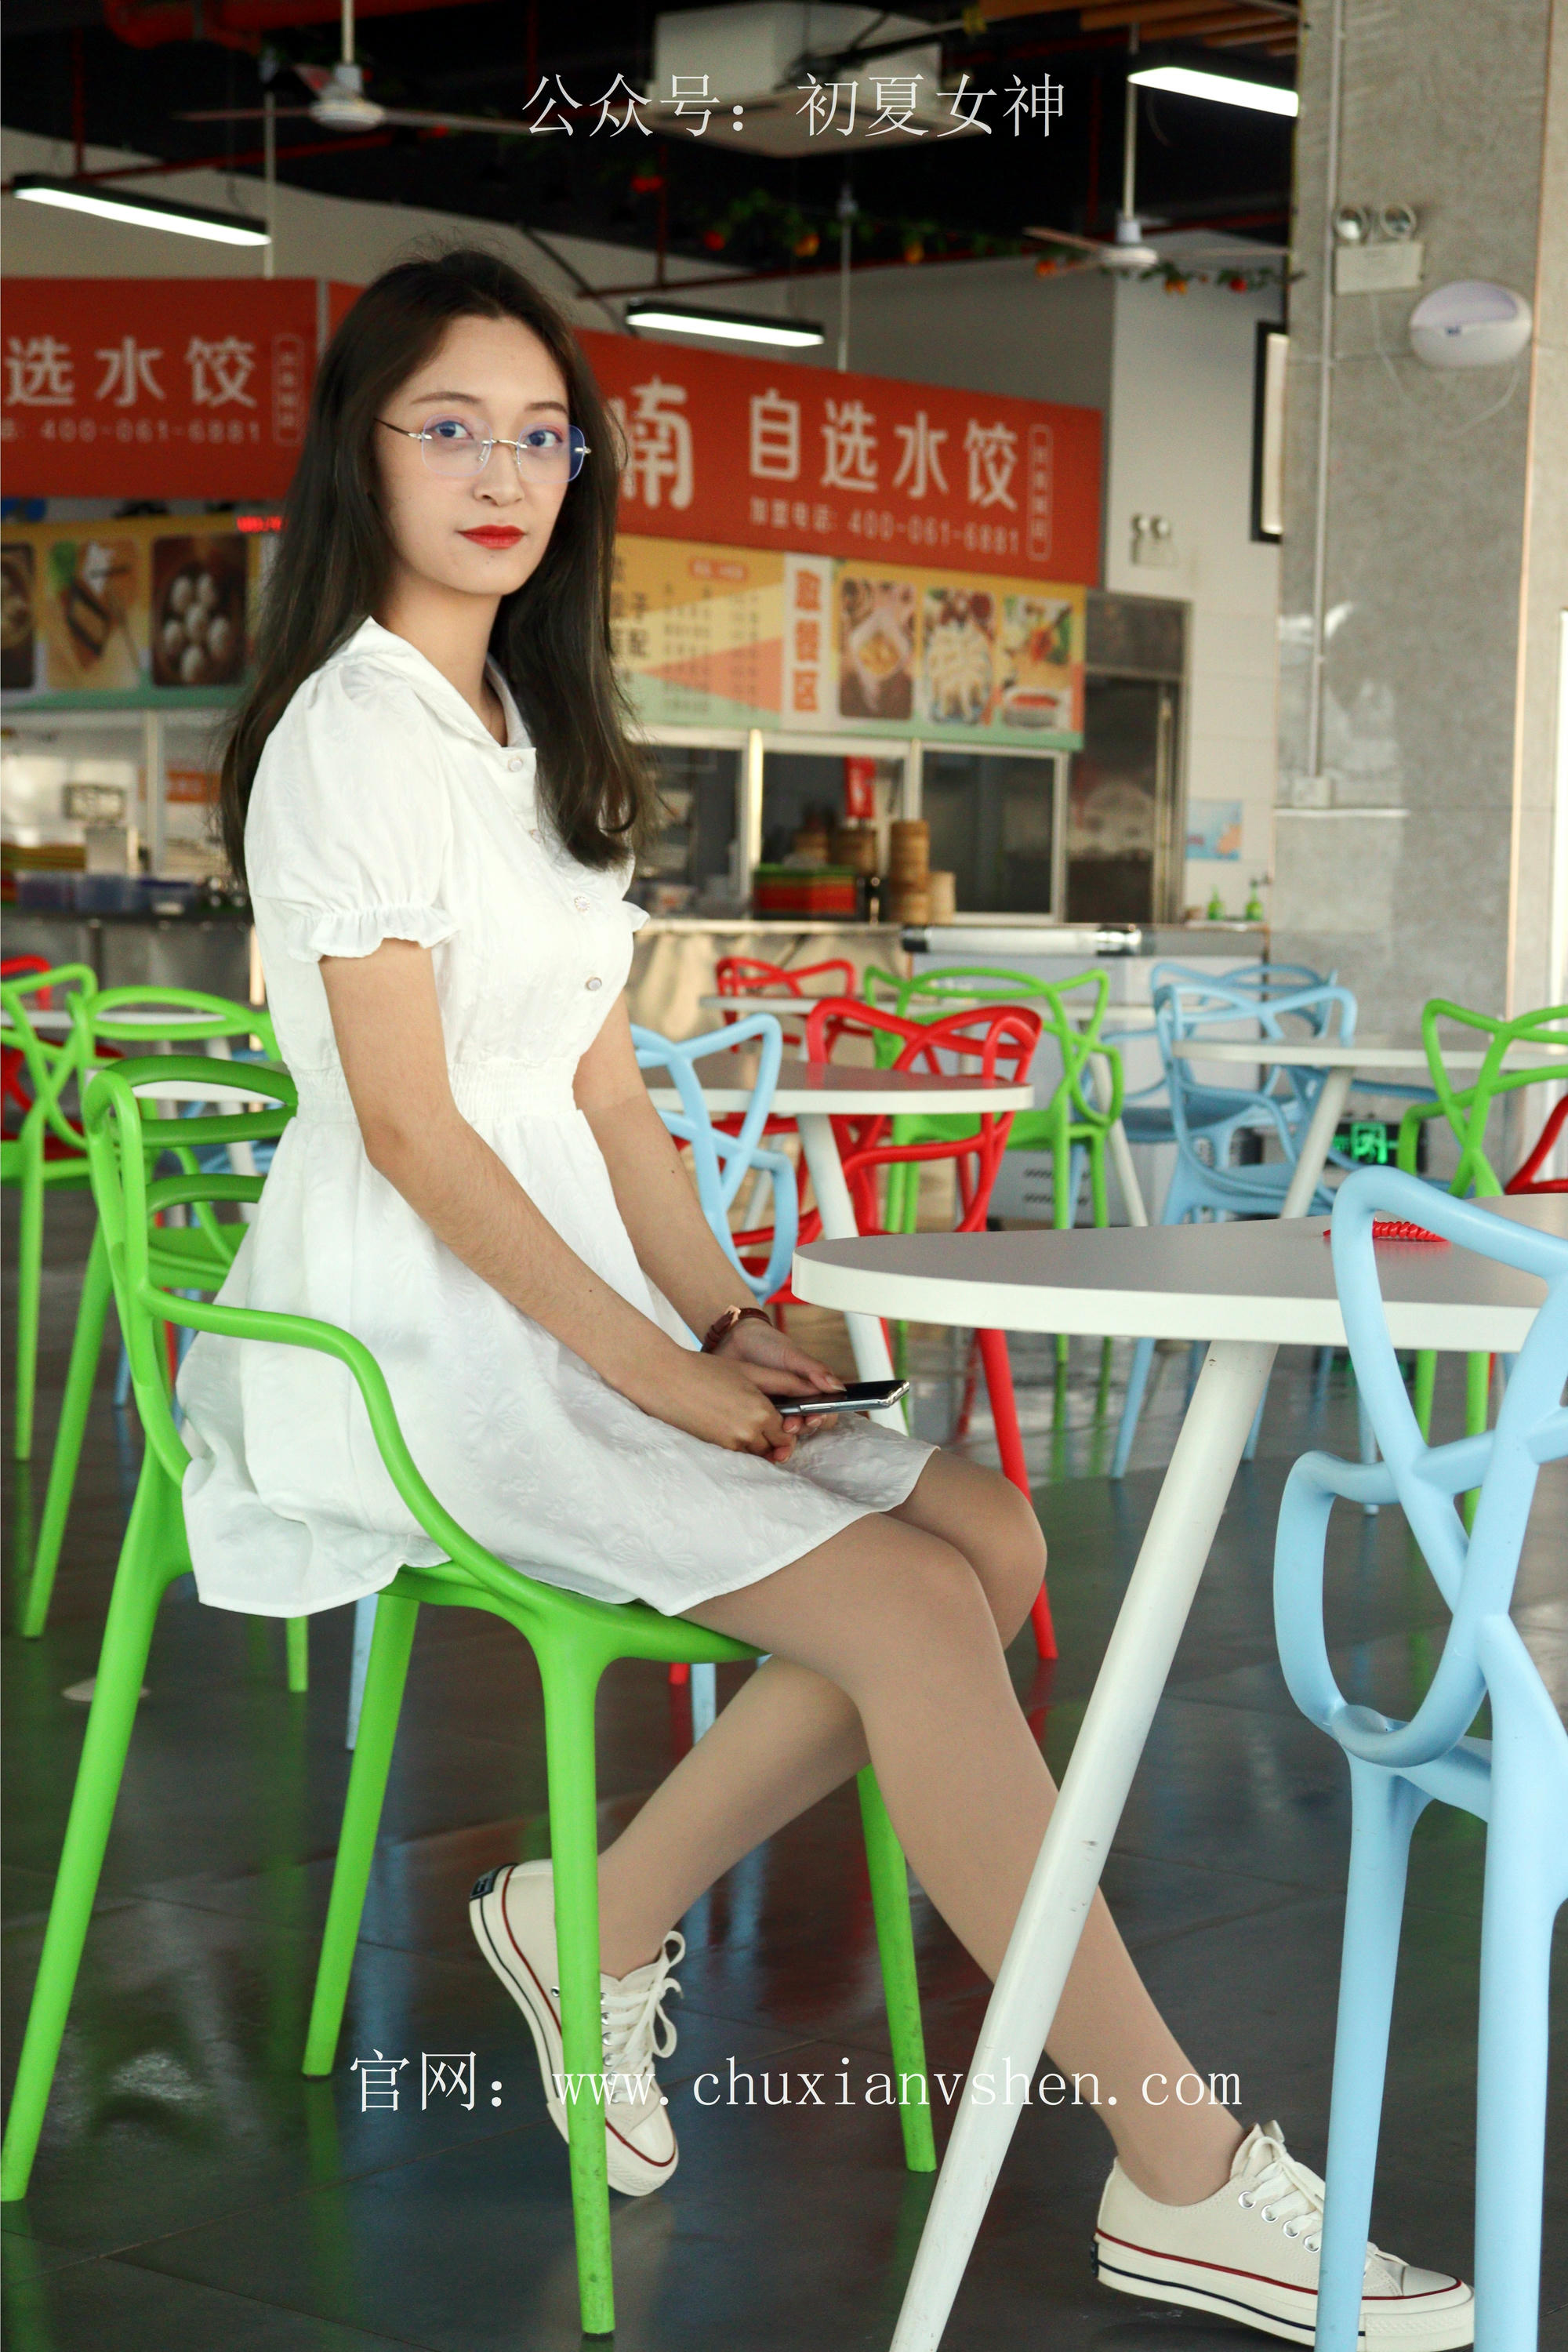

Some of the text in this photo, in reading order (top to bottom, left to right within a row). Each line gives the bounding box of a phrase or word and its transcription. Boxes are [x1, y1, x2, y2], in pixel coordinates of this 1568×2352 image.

[5, 335, 256, 407] 选水饺
[750, 389, 1018, 512] 自选水饺
